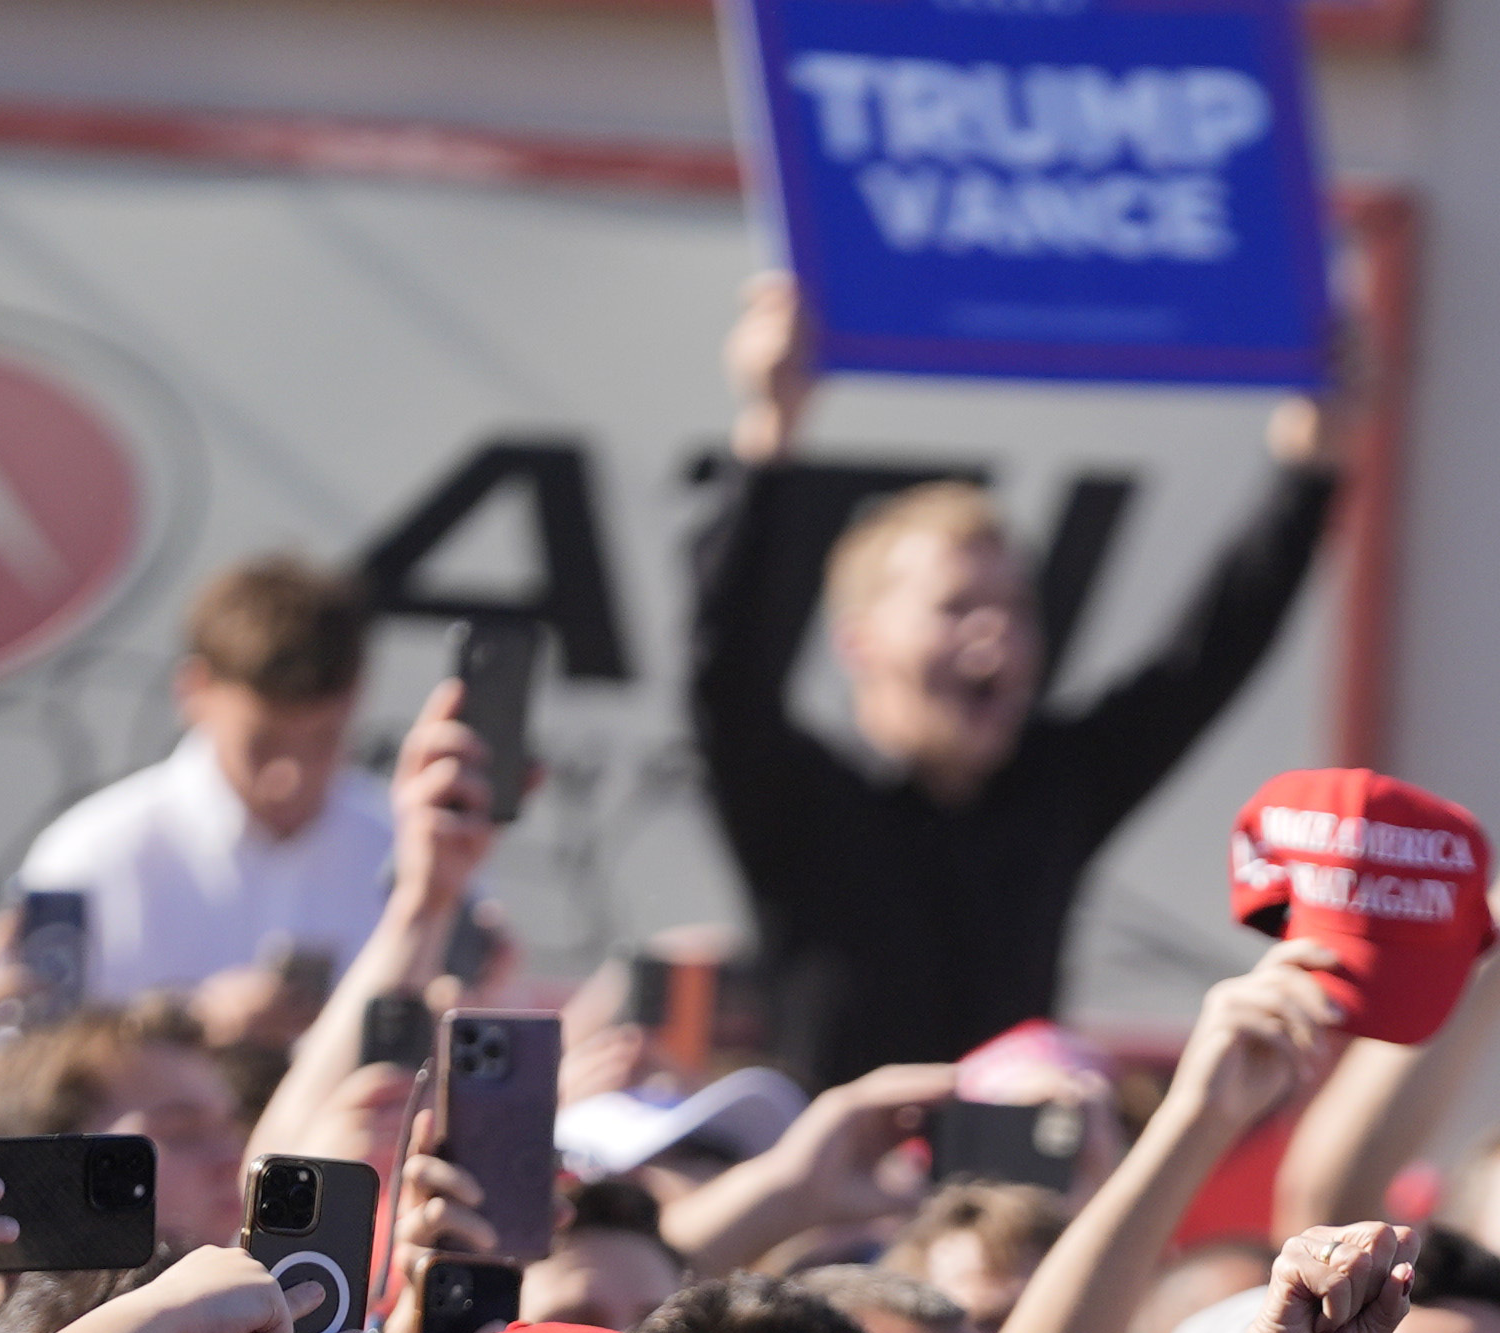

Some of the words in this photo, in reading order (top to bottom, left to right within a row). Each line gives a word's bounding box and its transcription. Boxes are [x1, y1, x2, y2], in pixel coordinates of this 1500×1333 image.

[792, 50, 1270, 170] TRUMP
[855, 163, 1238, 263] VANCE
[1259, 805, 1338, 851] MAKE
[1332, 816, 1476, 873] AMERICA
